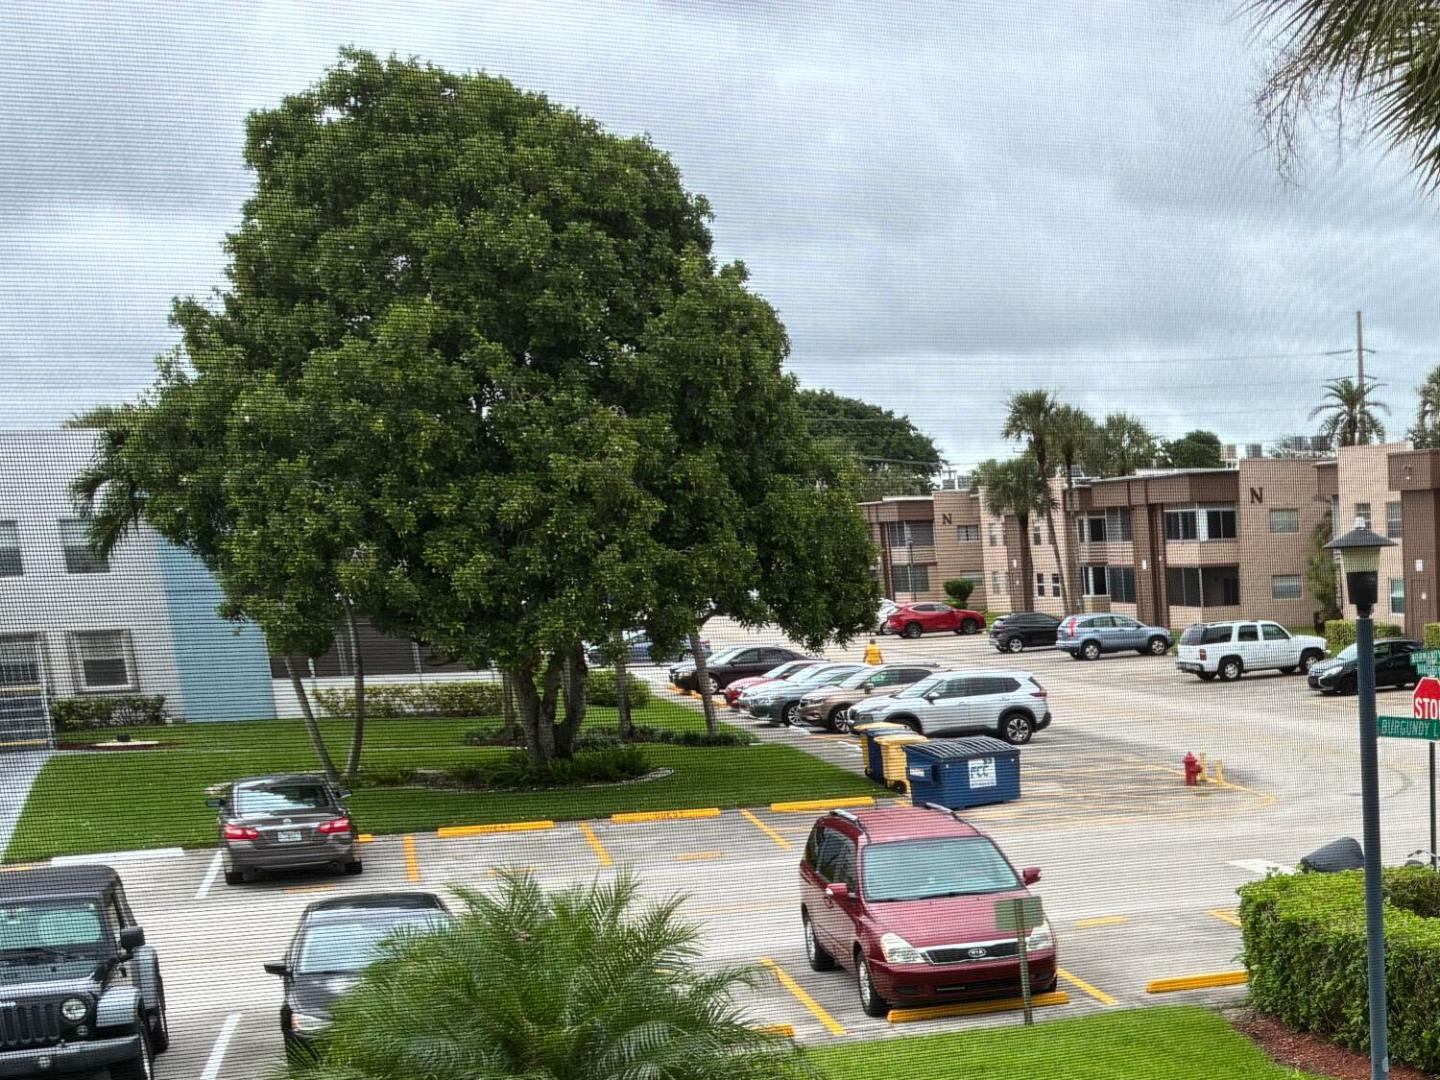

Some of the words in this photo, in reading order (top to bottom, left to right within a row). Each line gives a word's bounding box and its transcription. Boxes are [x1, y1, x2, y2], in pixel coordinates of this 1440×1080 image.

[1250, 487, 1263, 503] N
[942, 513, 952, 525] N
[1381, 719, 1430, 736] BURGUNDY
